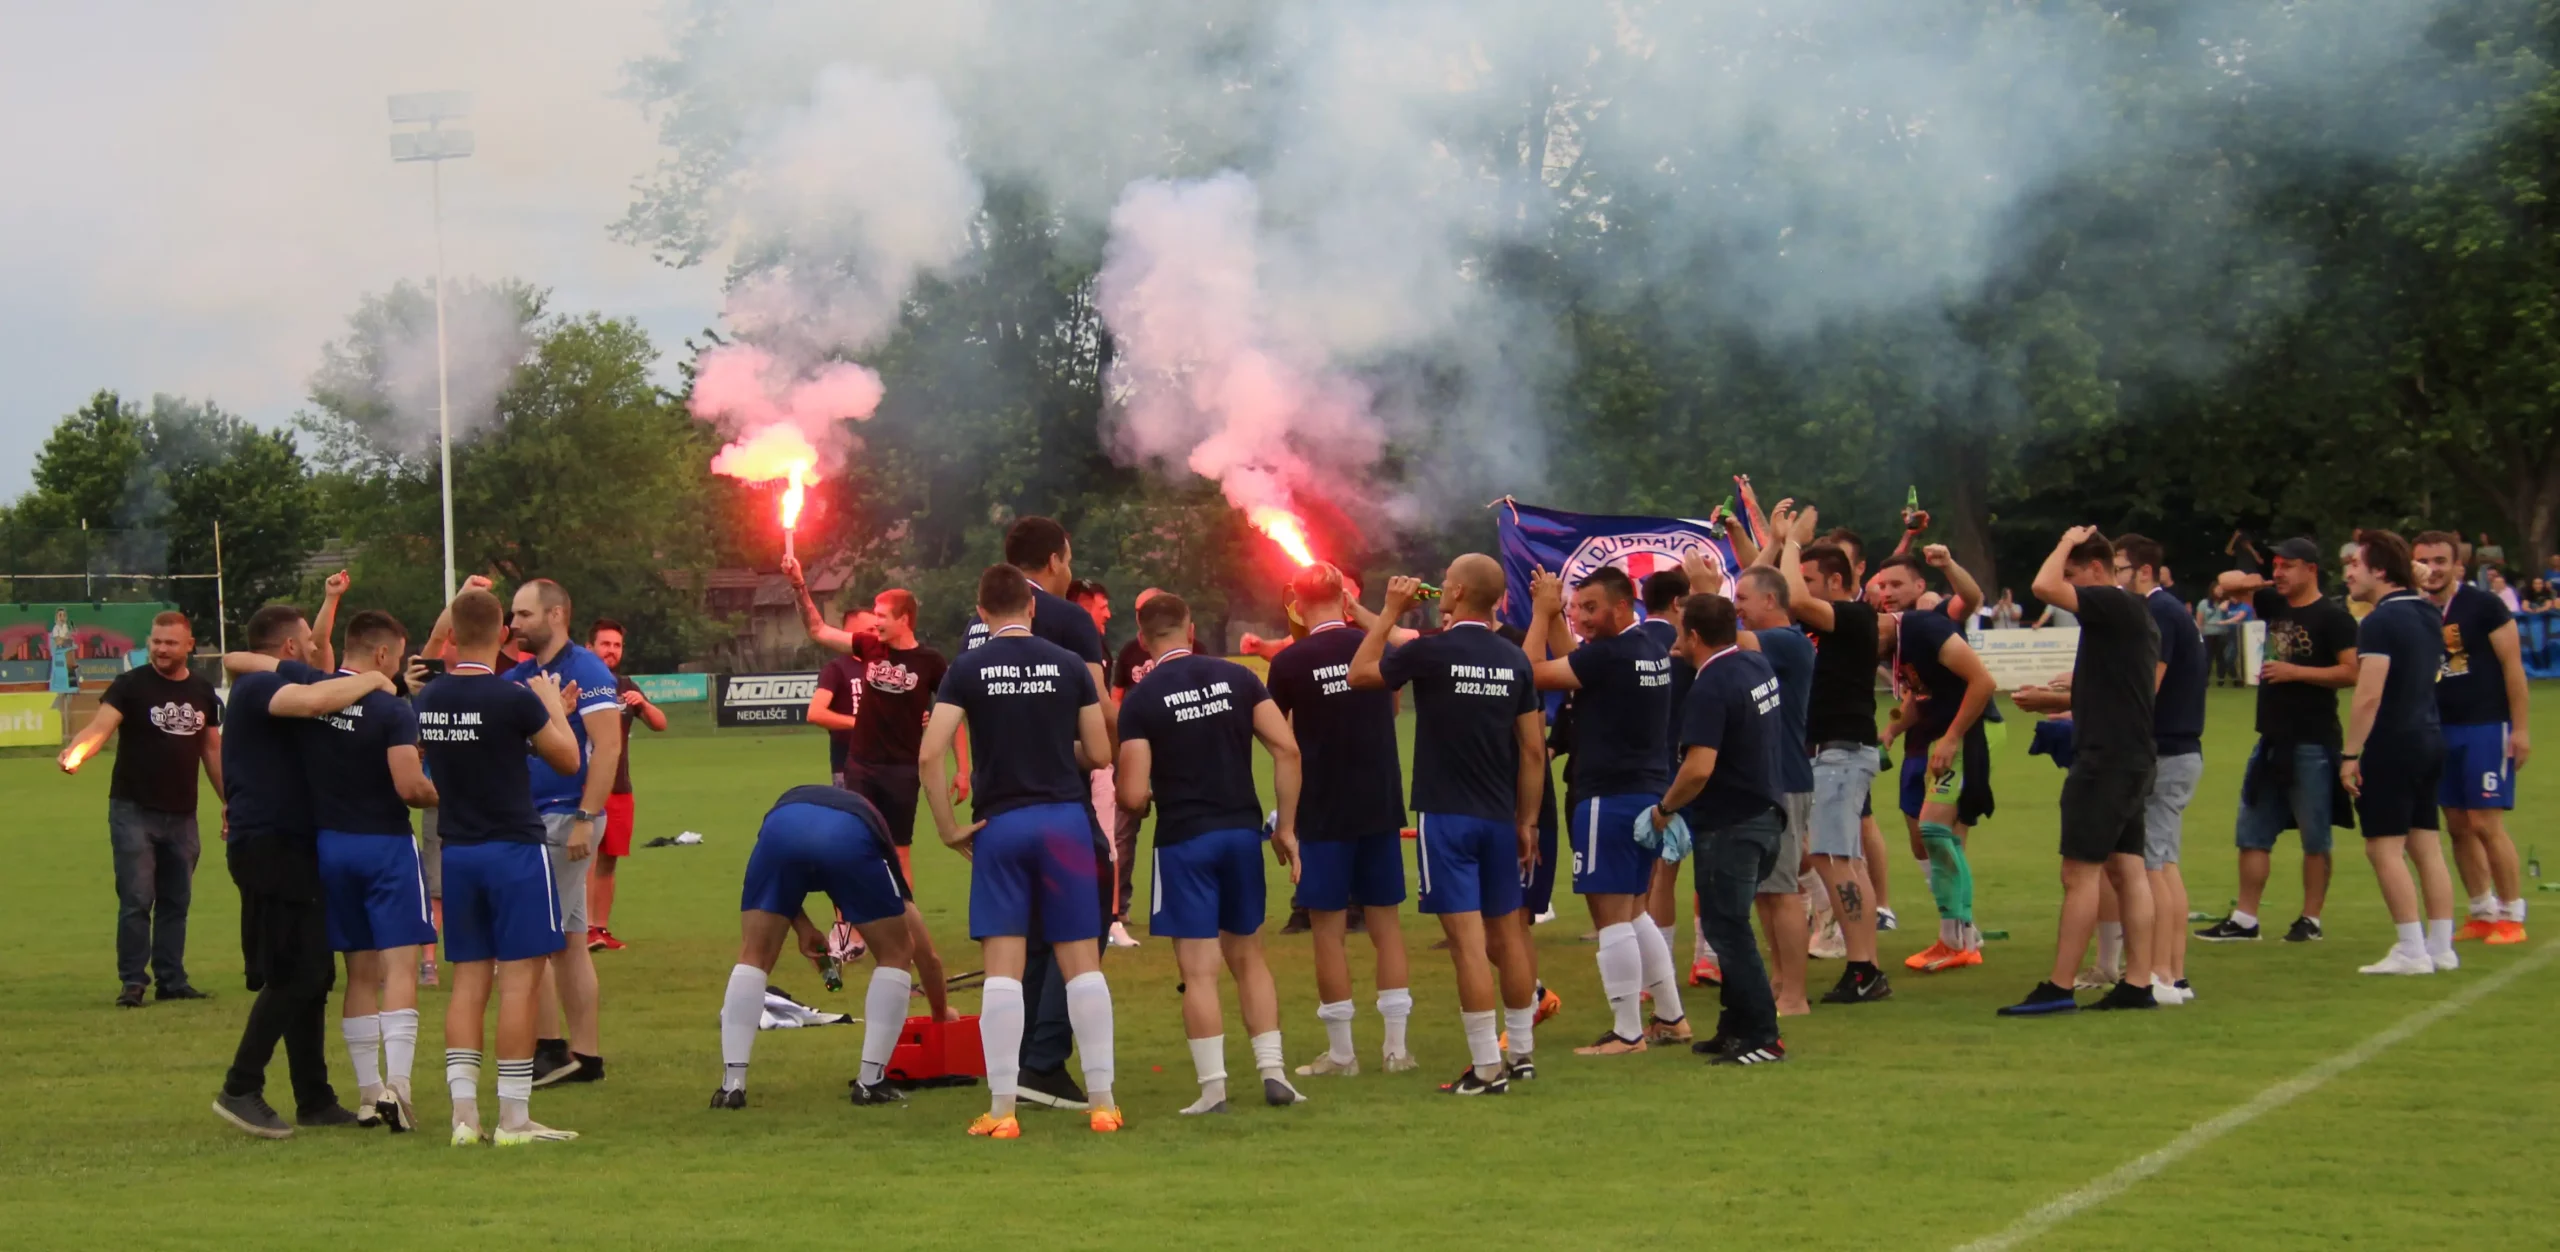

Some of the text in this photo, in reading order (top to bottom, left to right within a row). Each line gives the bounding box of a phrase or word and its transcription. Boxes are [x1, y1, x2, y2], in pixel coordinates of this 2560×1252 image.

[1569, 561, 1597, 588] NK
[980, 664, 1060, 680] PRVACI 1.MNL
[1312, 663, 1349, 681] PRVACI
[1450, 664, 1514, 681] PRVACI 1.MNL
[987, 680, 1056, 695] 2023./2024.
[1163, 681, 1233, 708] PRVACI 1.MNL
[1454, 681, 1509, 697] 2023./2024.
[419, 711, 483, 725] PRVACI 1.MNL
[736, 708, 787, 720] NEDELIŠĆE
[1174, 698, 1233, 722] 2023./2024.
[422, 728, 479, 741] 2023./2024.
[2482, 771, 2498, 791] 6
[1573, 851, 1583, 875] 6
